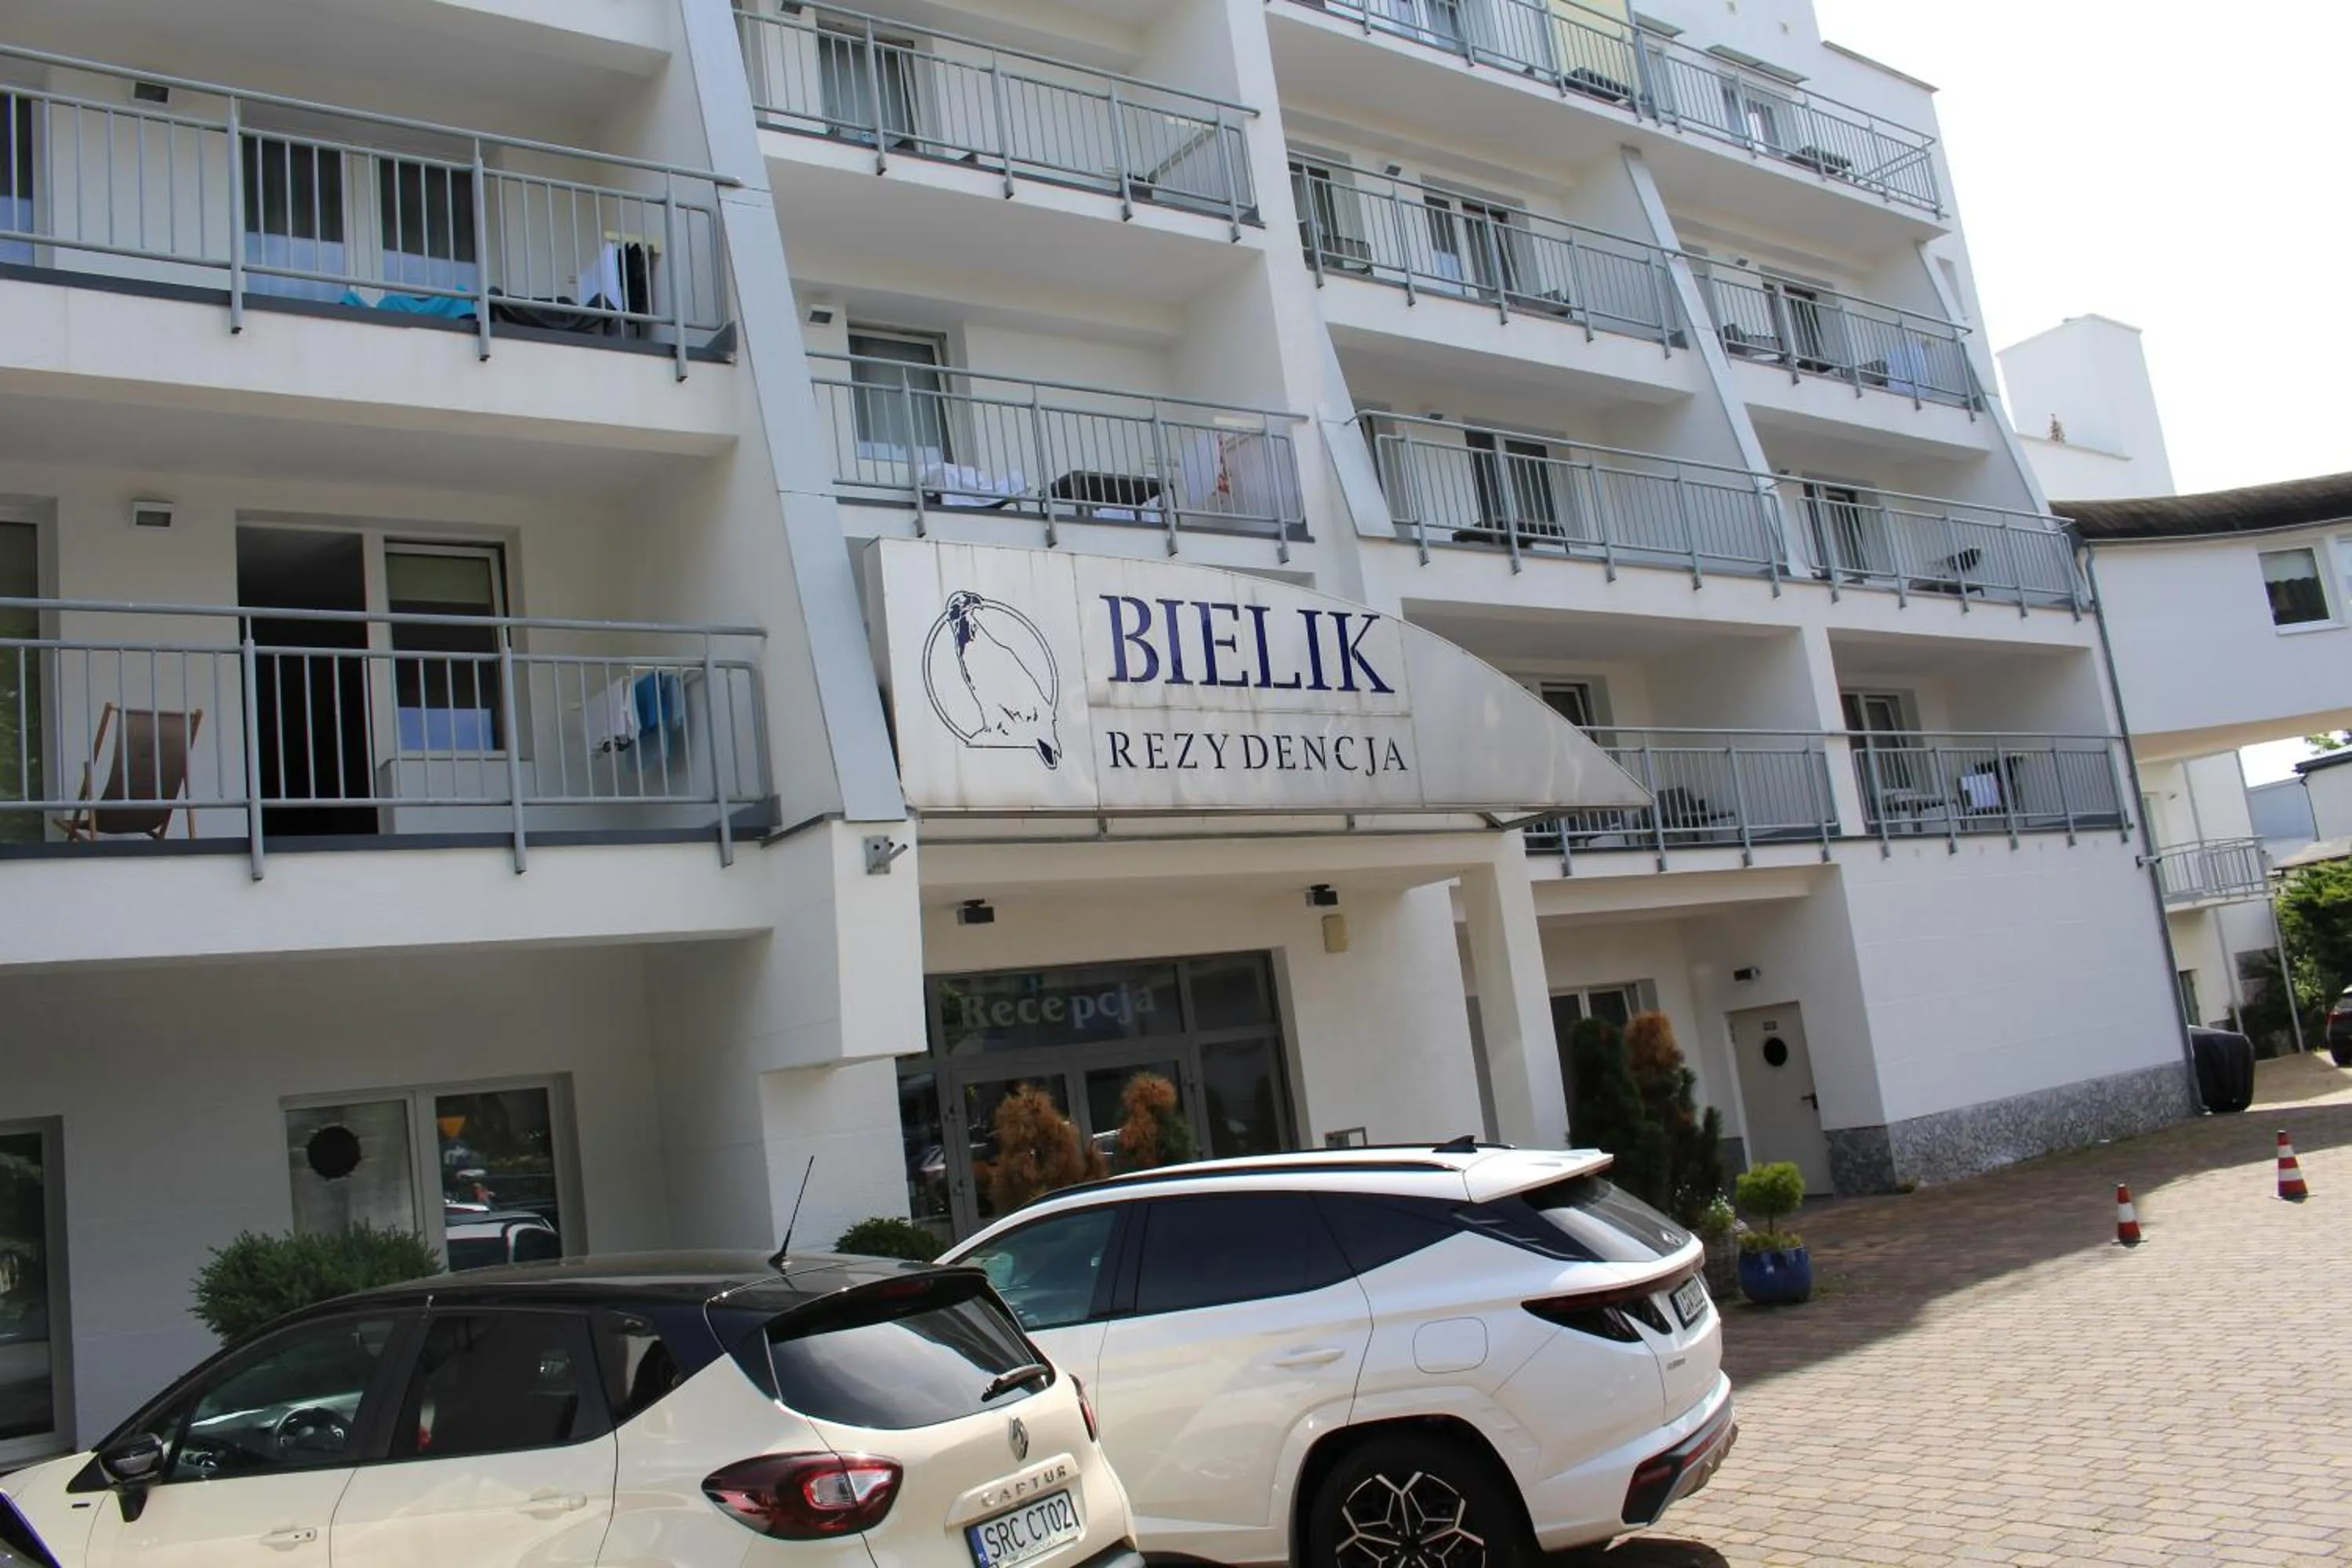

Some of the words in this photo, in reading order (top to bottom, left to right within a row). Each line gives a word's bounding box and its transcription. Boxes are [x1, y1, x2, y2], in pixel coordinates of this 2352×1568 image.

[1099, 594, 1395, 694] BIELIK
[1106, 731, 1408, 777] REZYDENCJA
[960, 982, 1156, 1030] Recepcja
[981, 1465, 1067, 1507] CAPTUR
[985, 1517, 1026, 1559] SRC
